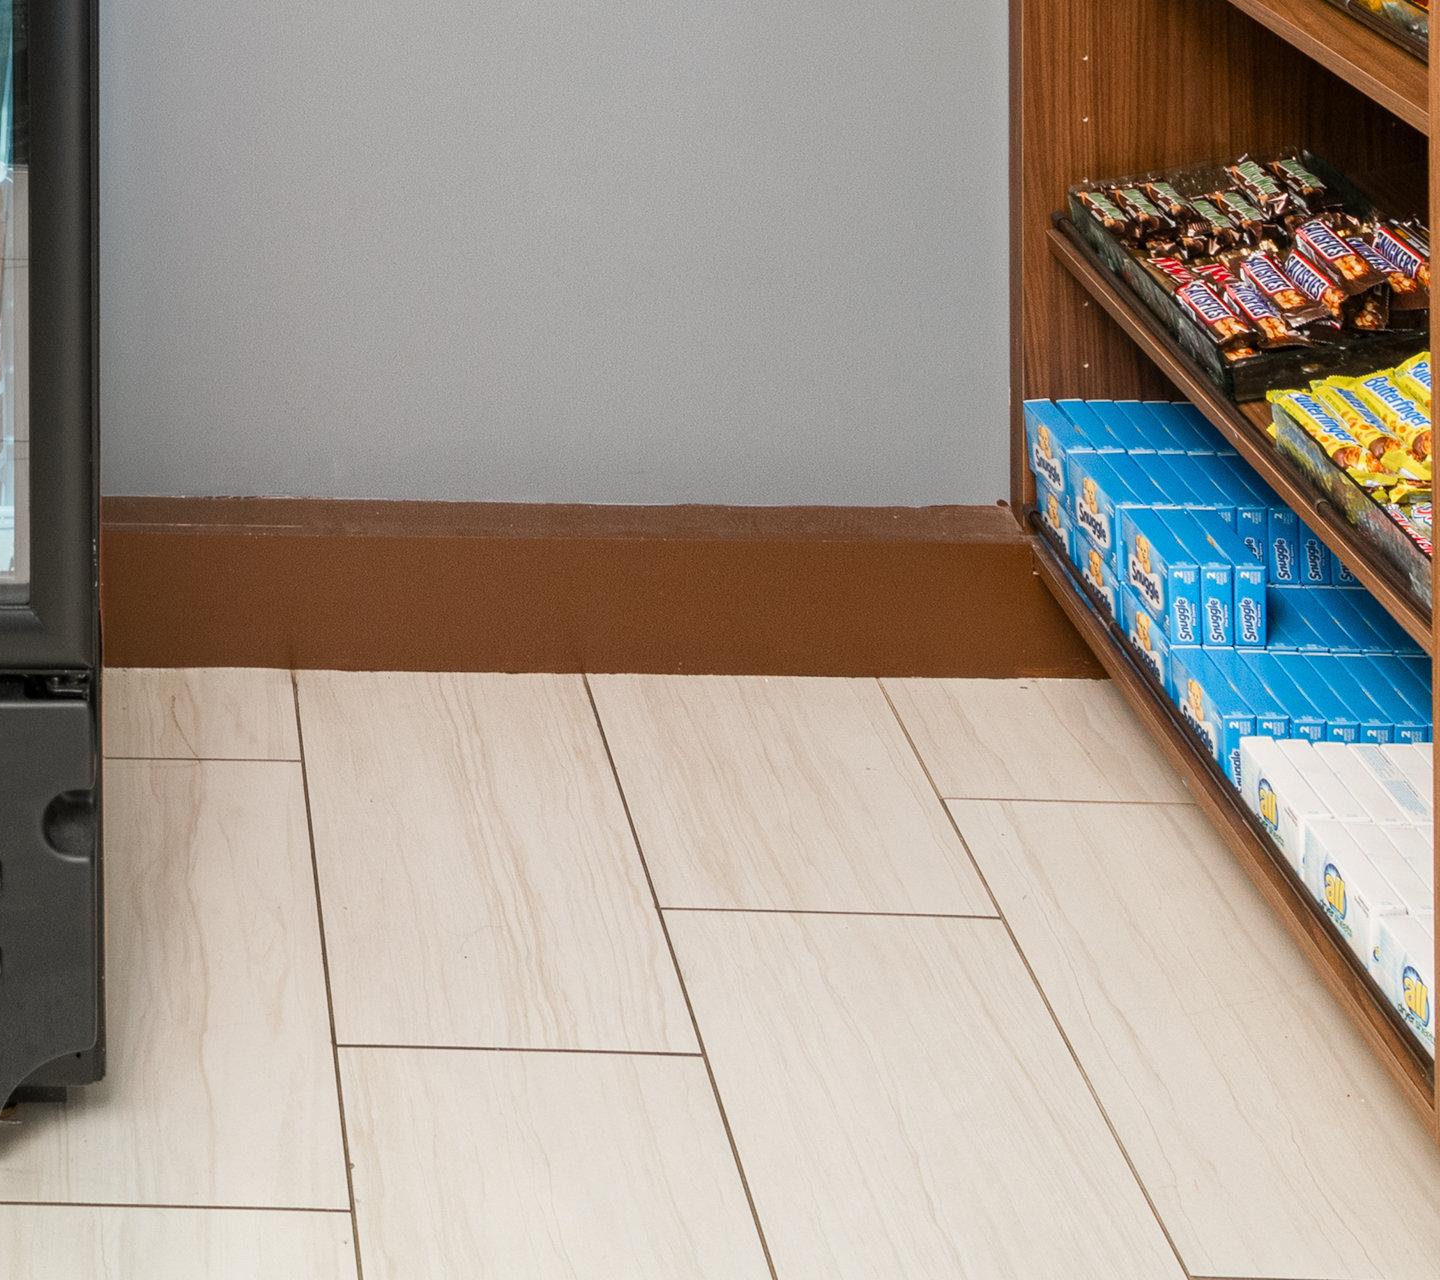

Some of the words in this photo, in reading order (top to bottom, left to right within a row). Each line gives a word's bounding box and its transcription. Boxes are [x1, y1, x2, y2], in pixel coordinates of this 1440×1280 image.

[1362, 376, 1431, 428] Butterfinger
[1079, 503, 1108, 544] Snuggle
[1276, 537, 1293, 581] Snuggle
[1308, 539, 1323, 582] Snuggle
[1131, 561, 1160, 605] Snuggle
[1174, 598, 1193, 641] Snuggle
[1207, 598, 1225, 642] Snuggle
[1239, 598, 1258, 642] Snuggle
[1259, 789, 1278, 830] all
[1325, 875, 1346, 914] all
[1404, 978, 1429, 1022] all
